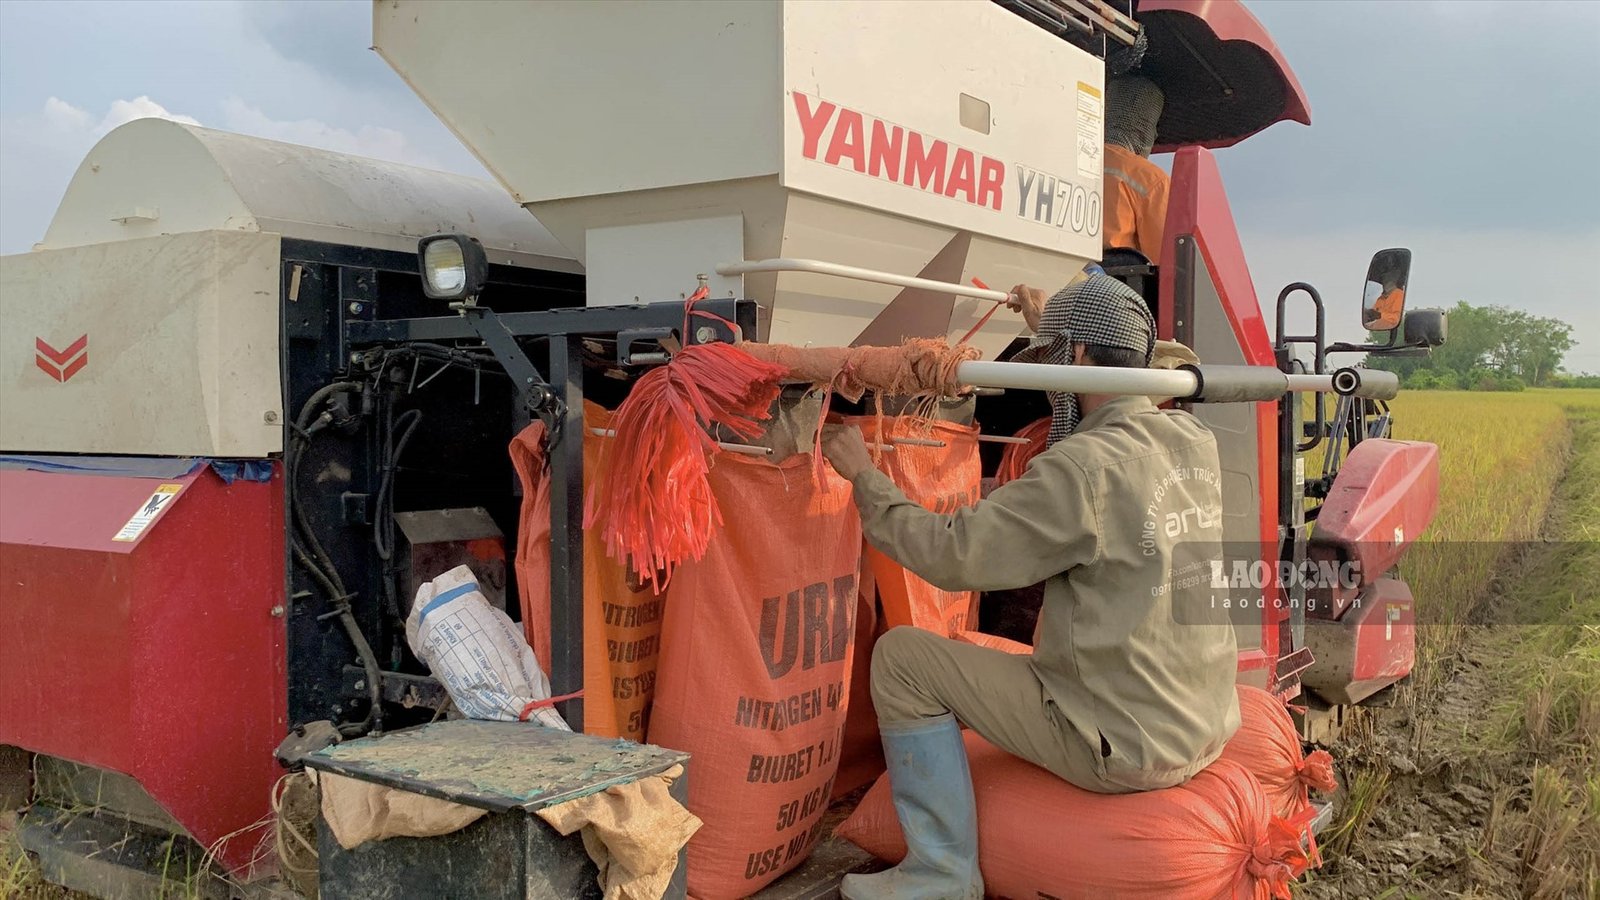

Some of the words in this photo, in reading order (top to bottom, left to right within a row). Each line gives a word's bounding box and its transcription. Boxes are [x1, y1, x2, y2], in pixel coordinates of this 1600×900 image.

[793, 91, 1005, 211] YANMAR
[1016, 166, 1101, 237] YH700
[1147, 501, 1159, 518] TY
[1138, 521, 1157, 556] CÔNG
[747, 745, 814, 784] BIURET
[776, 800, 799, 832] 50
[800, 787, 820, 821] KG
[744, 844, 784, 880] USE
